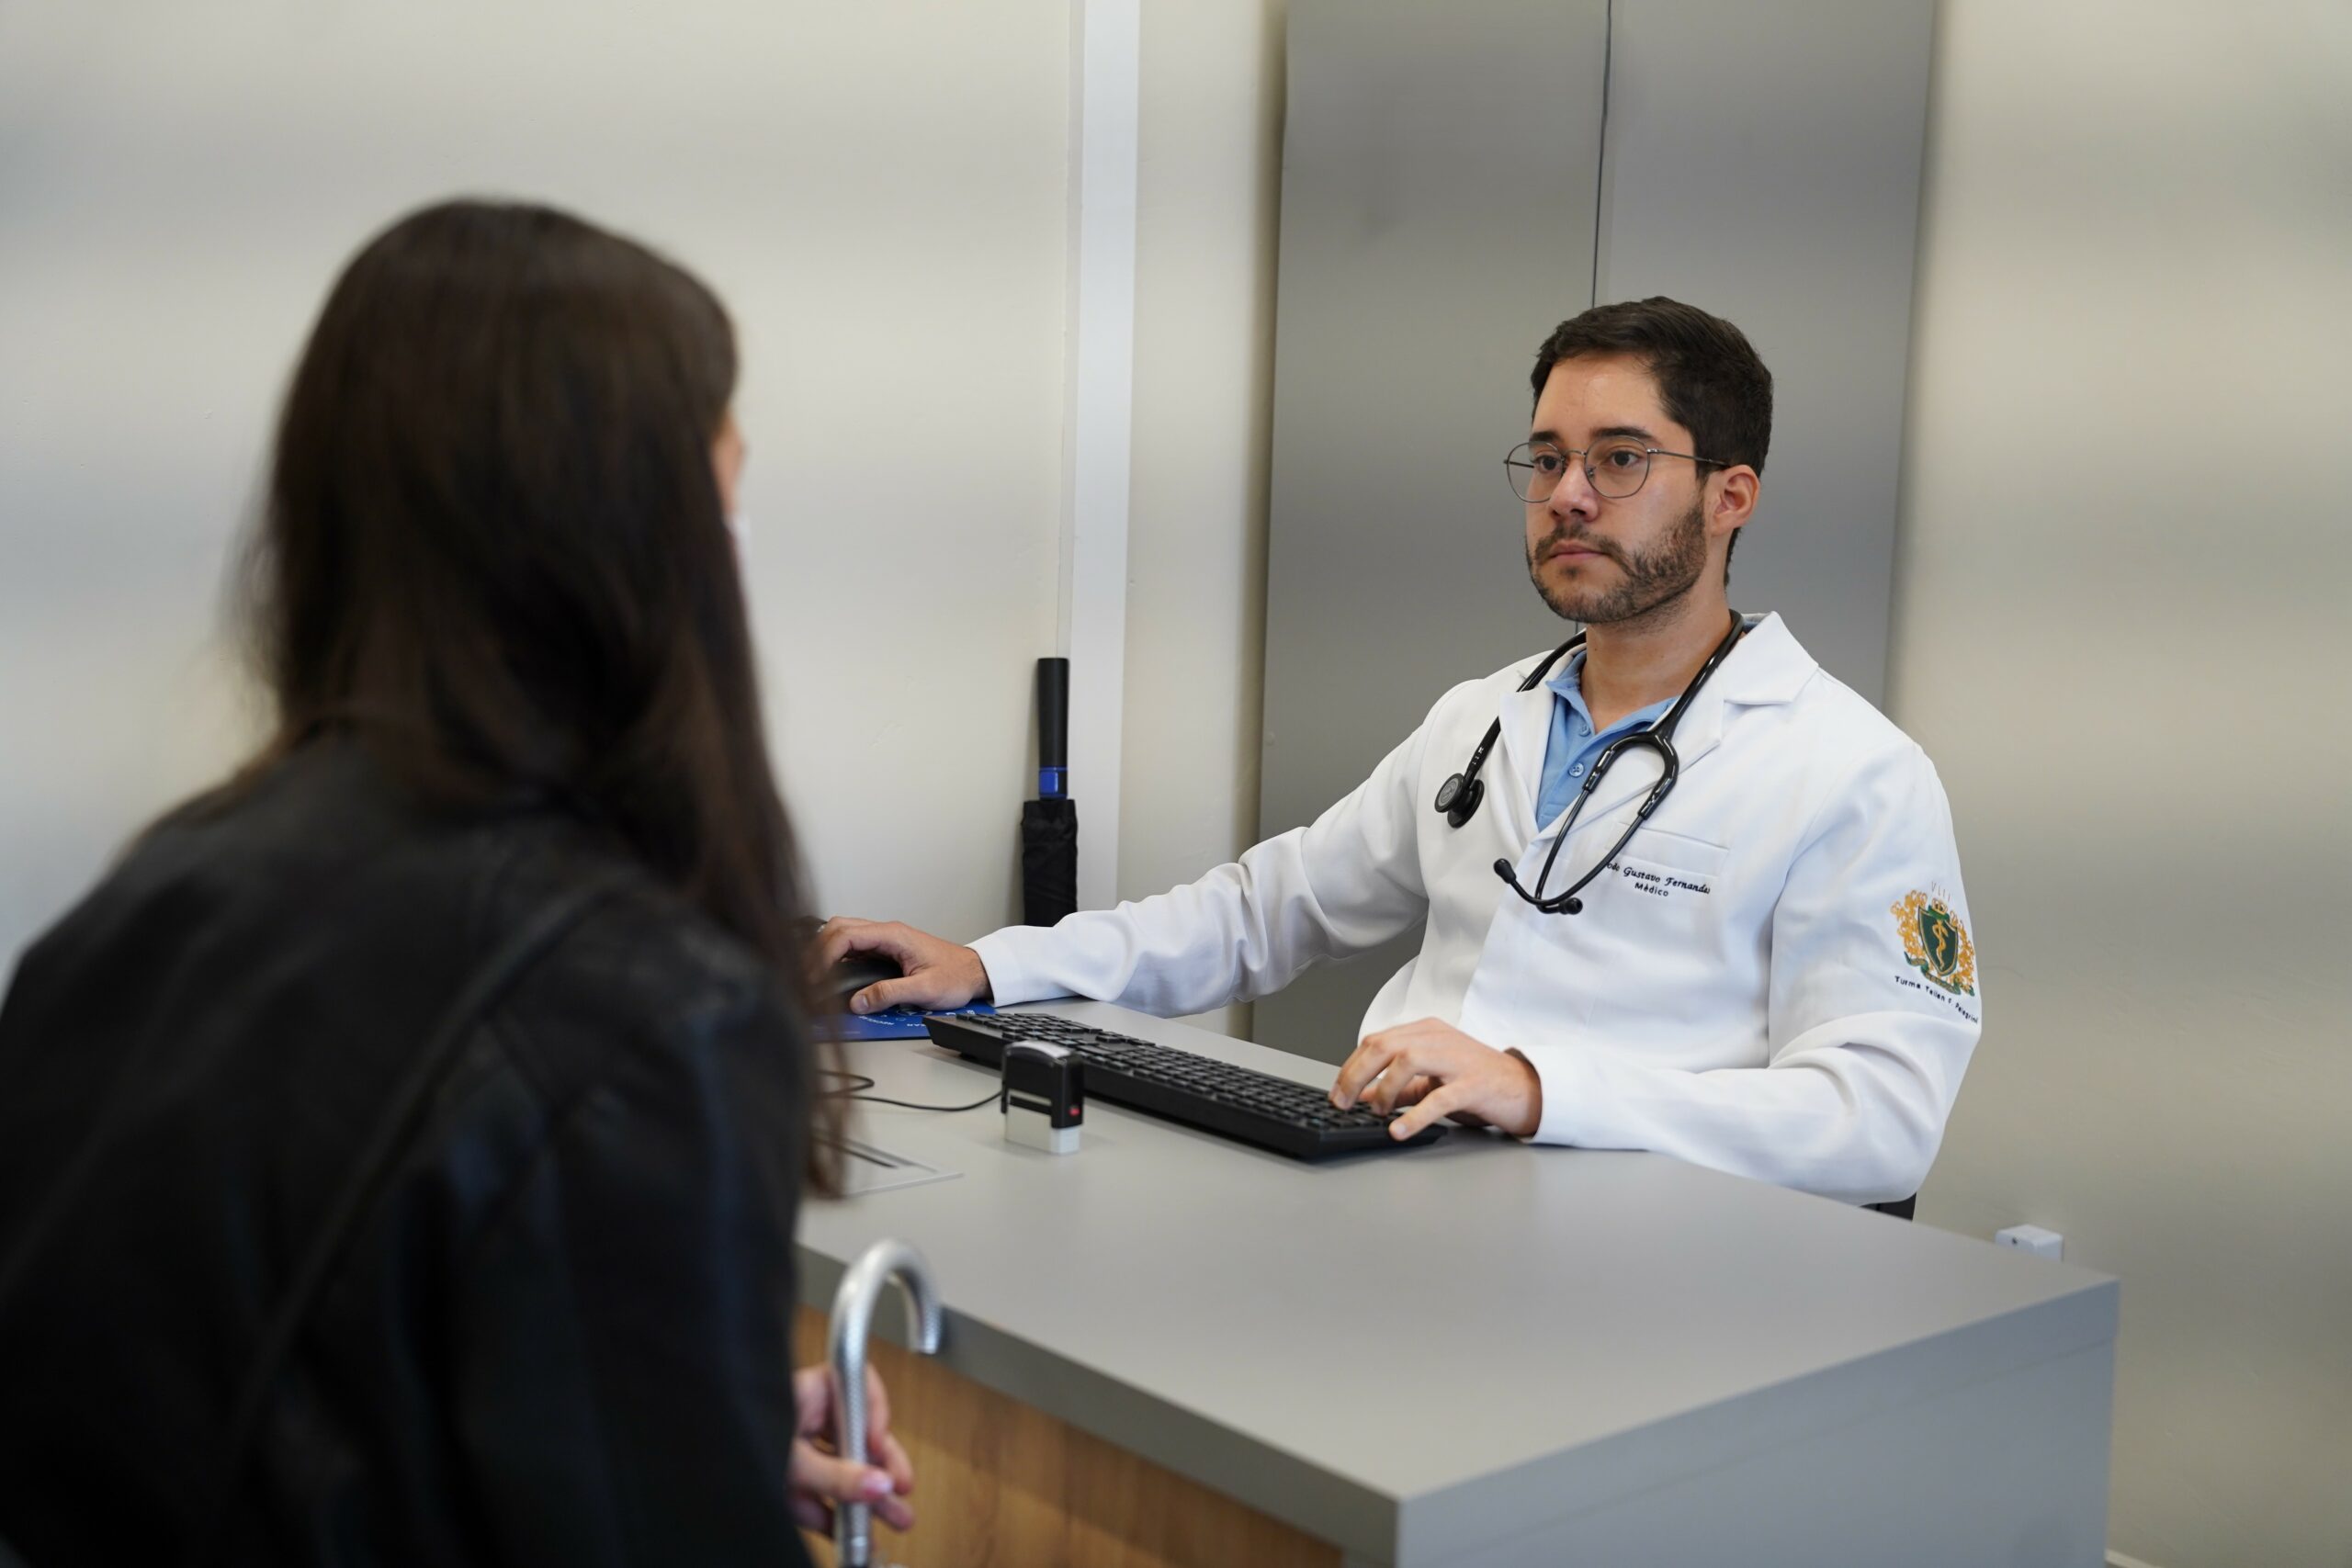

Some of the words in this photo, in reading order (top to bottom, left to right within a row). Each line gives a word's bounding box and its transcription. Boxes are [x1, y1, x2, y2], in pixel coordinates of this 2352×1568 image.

[1623, 866, 1660, 883] Gustavo
[1634, 882, 1668, 897] Médico
[1894, 976, 1921, 989] Turma
